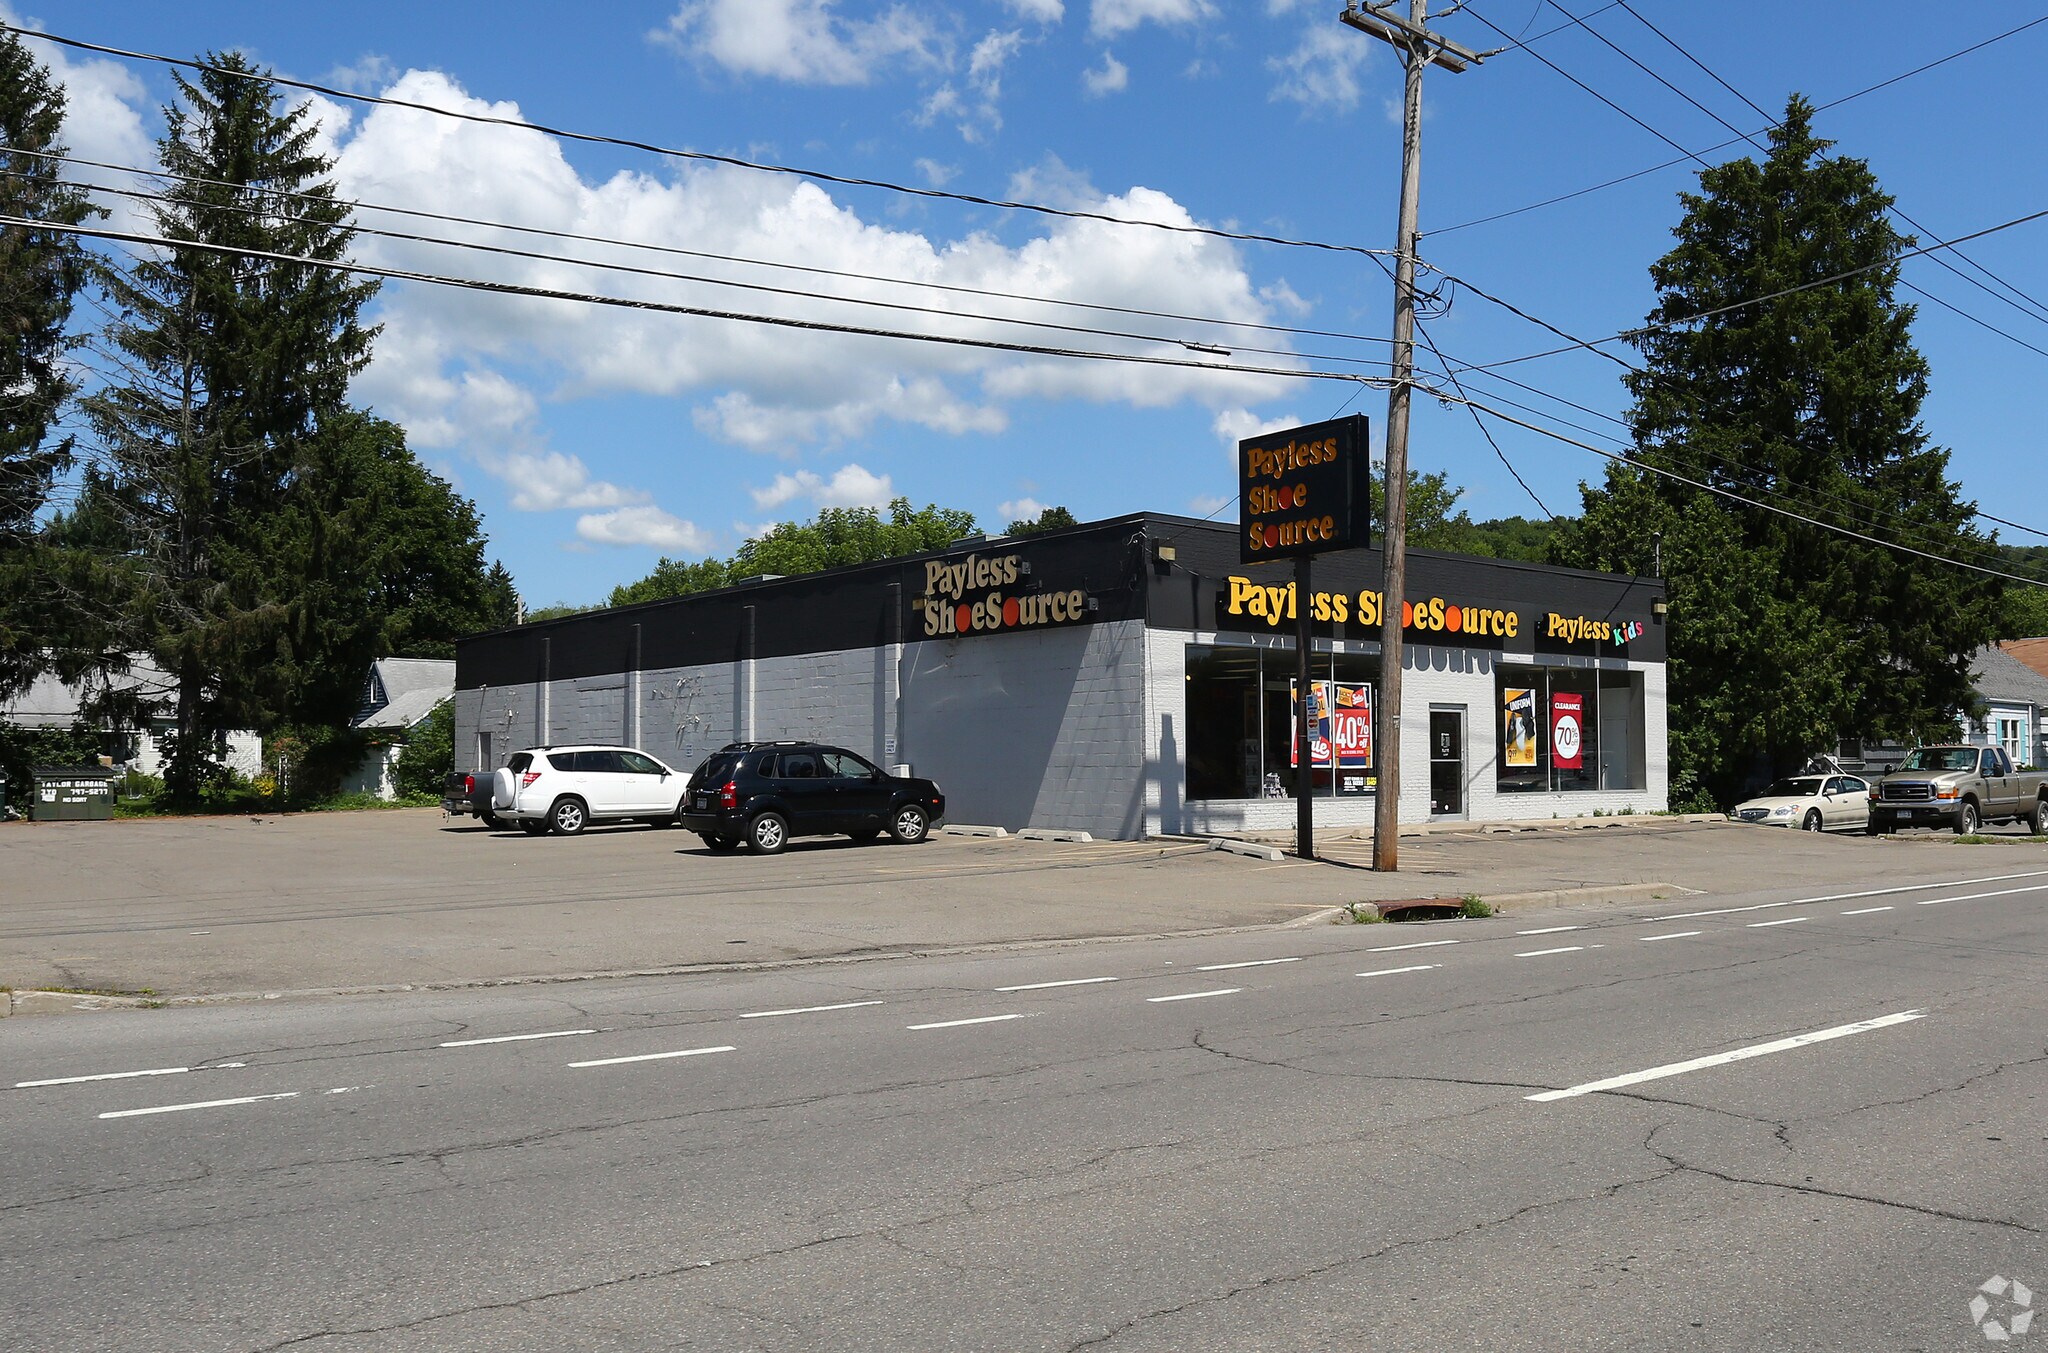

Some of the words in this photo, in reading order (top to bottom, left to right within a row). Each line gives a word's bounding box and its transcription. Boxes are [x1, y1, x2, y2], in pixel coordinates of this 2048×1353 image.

[1247, 438, 1338, 479] Payless
[1248, 483, 1307, 515] Shoe
[1249, 515, 1334, 551] Source
[924, 553, 1018, 600] Payless
[924, 589, 1083, 636] ShoeSource
[1227, 575, 1348, 626] Paylss
[1547, 612, 1610, 644] Payless
[1612, 620, 1644, 647] Kids
[1509, 697, 1531, 711] UNIFORM
[1554, 702, 1581, 711] CLEARANCE
[41, 780, 72, 788] TAYLOR
